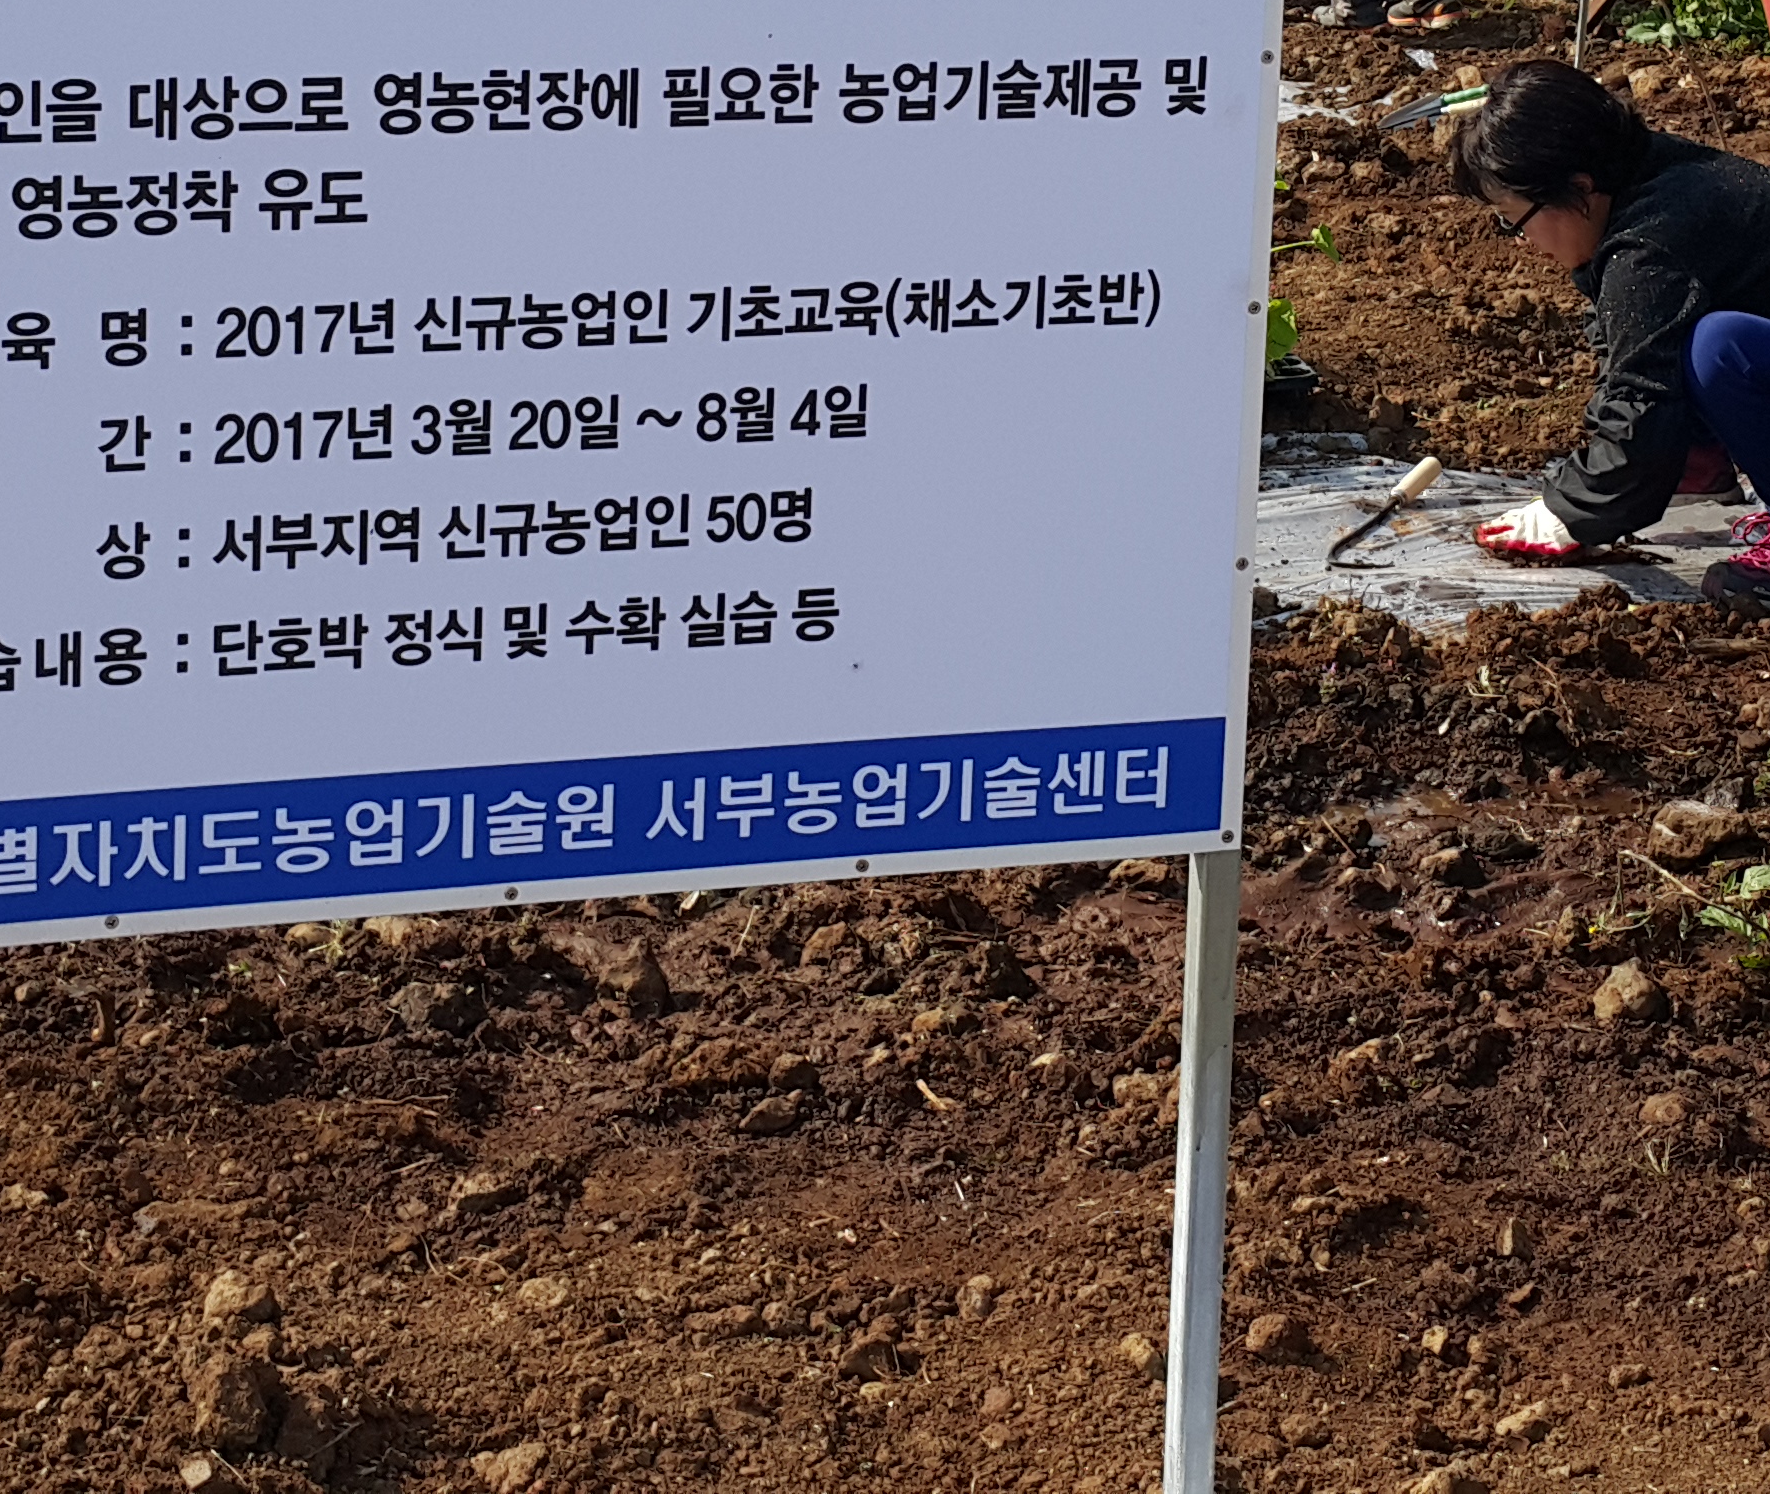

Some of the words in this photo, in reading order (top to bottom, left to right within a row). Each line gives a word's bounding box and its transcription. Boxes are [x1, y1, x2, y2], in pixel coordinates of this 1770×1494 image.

[129, 75, 349, 141] 대상으로
[373, 67, 640, 136] 영농현장에
[662, 63, 820, 128] 필요한
[838, 58, 1142, 124] 농업기술제공
[1164, 55, 1208, 116] 및
[11, 169, 239, 240] 영농정착
[258, 168, 369, 231] 유도
[215, 298, 395, 359] 2017년
[413, 288, 668, 353] 신규농업인
[214, 403, 393, 465] 2017년
[410, 398, 492, 457] 3월
[508, 393, 619, 451] 20일
[696, 386, 775, 444] 8월
[790, 383, 868, 439] 4일
[212, 506, 420, 572] 서부지역
[438, 493, 690, 560] 신규농업인
[706, 486, 813, 544] 50명
[213, 613, 369, 677] 단호박
[384, 606, 483, 667] 정식
[503, 602, 548, 660] 및
[565, 596, 667, 655] 수확
[679, 590, 778, 649] 실습
[791, 587, 840, 642] 등
[645, 745, 1171, 844] 서부농업기술센터
